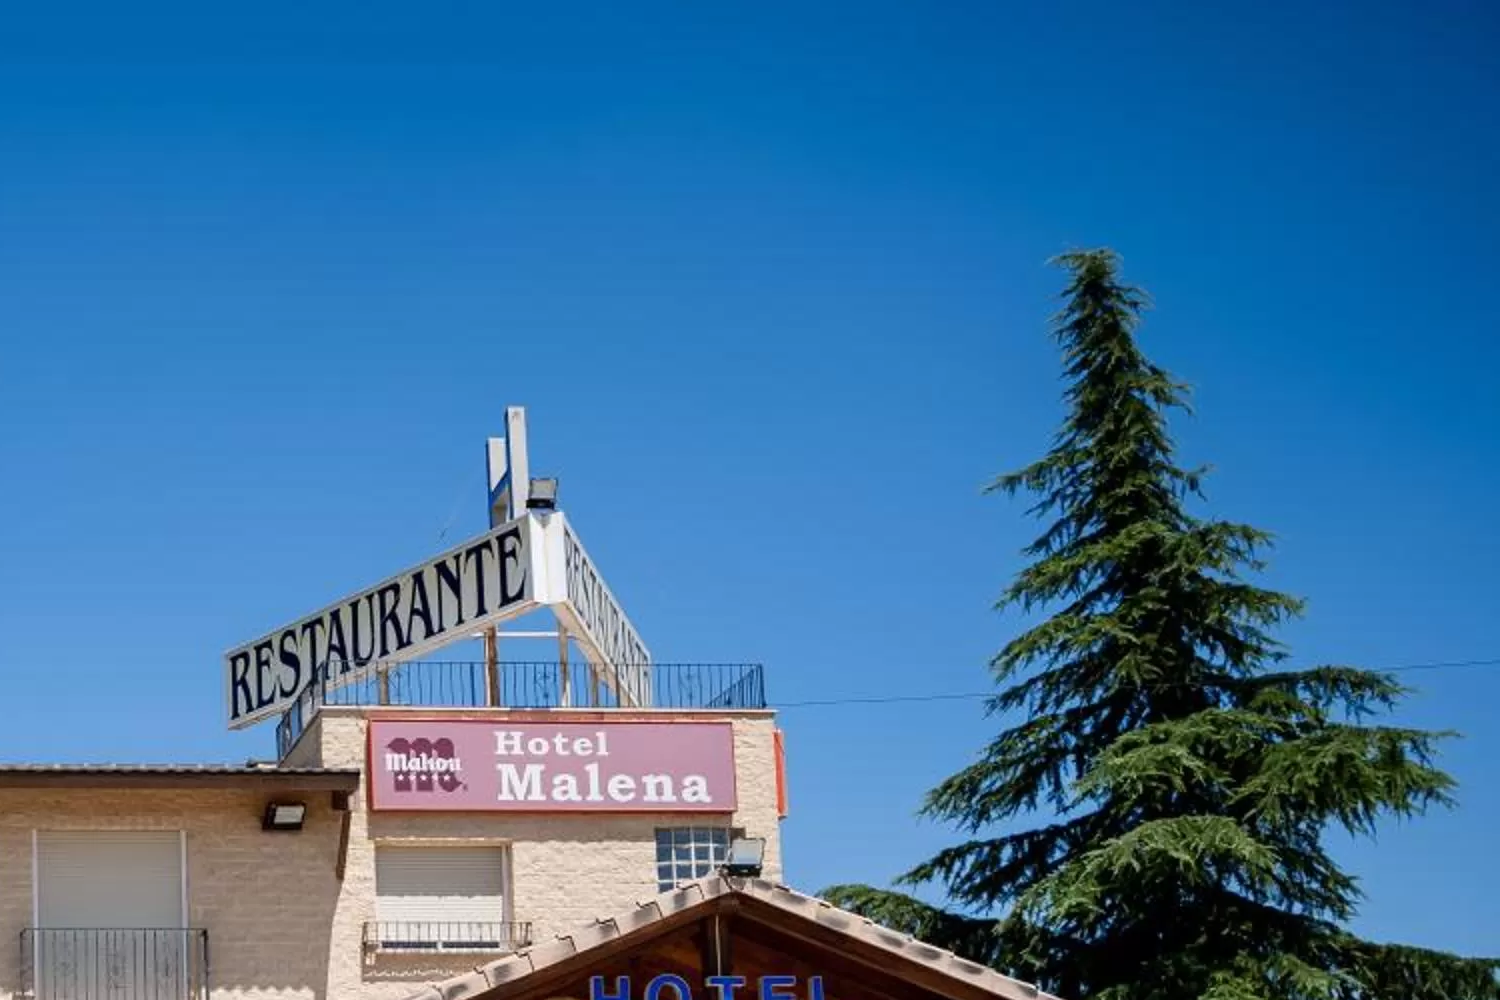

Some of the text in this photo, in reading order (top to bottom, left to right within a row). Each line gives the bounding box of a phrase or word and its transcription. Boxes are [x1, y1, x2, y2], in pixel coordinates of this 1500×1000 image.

[229, 526, 527, 720] RESTAURANTE
[493, 731, 609, 756] Hotel
[385, 750, 462, 771] Mahou
[496, 762, 712, 803] Malena
